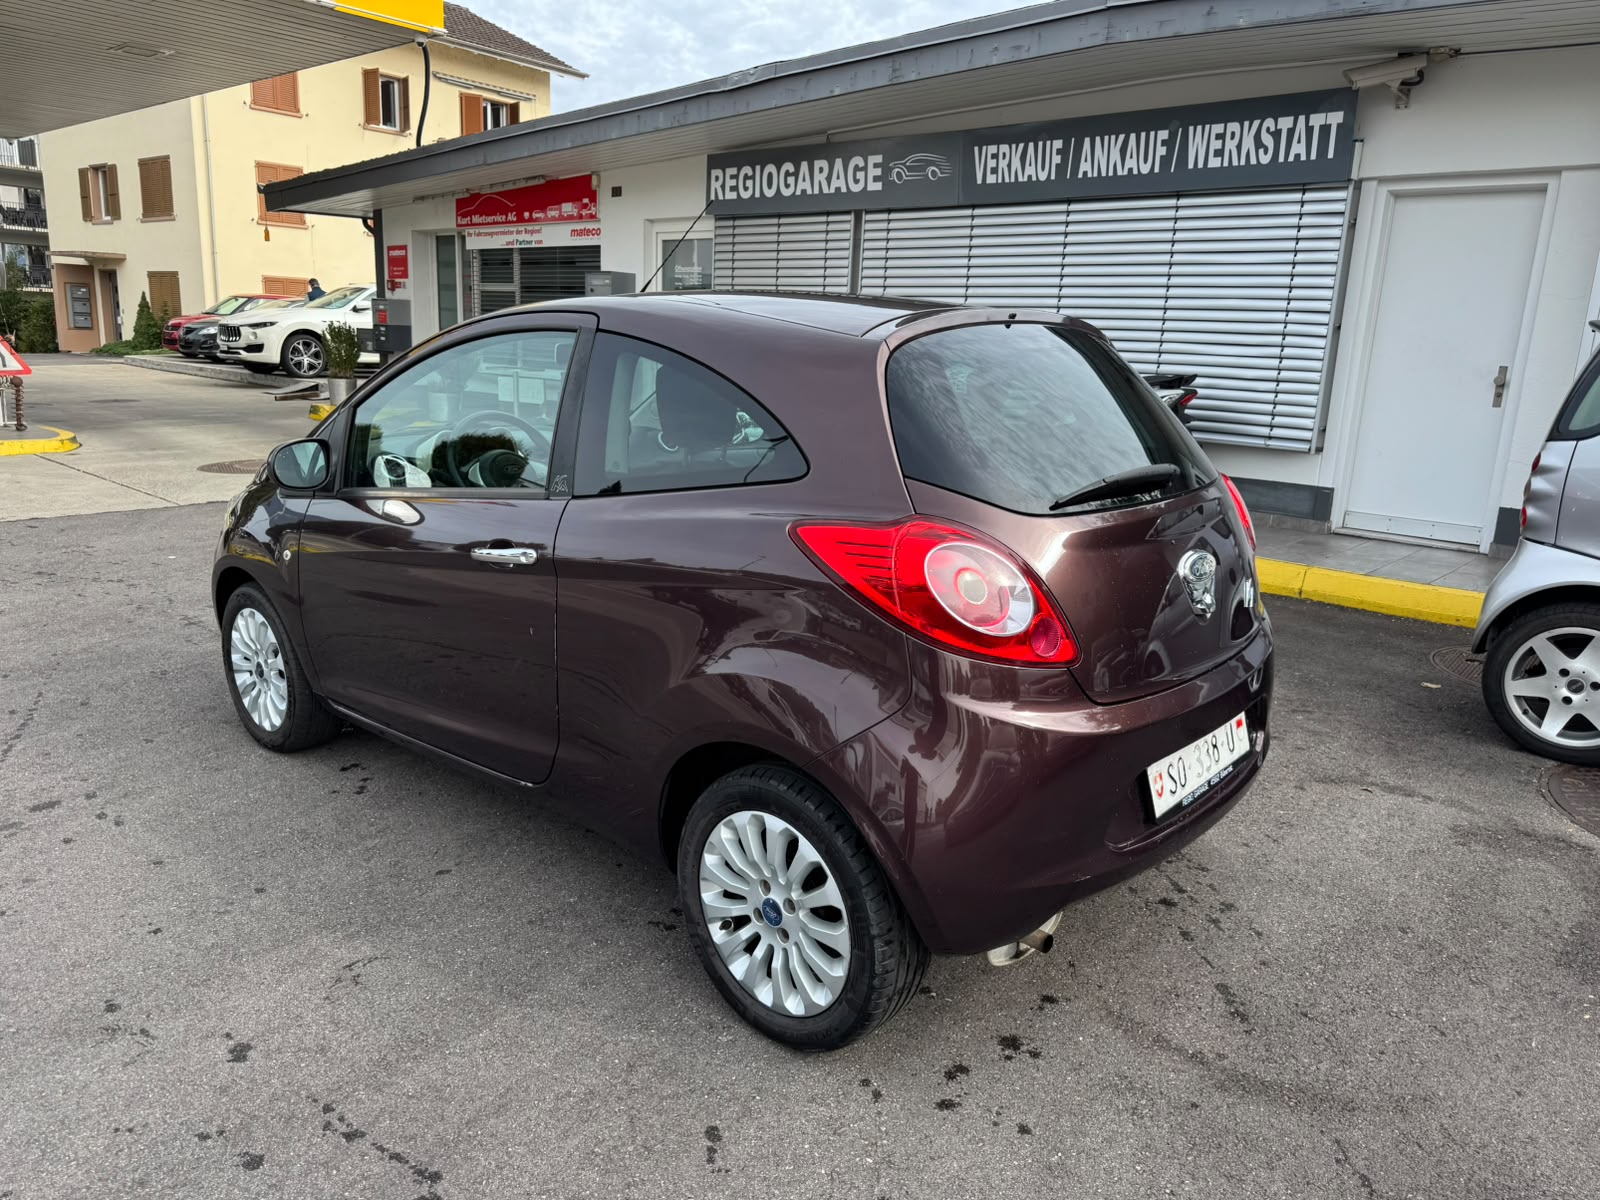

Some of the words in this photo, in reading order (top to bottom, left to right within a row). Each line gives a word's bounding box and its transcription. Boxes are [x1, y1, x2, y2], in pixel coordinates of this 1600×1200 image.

[974, 139, 1063, 184] VERKAUF
[1066, 137, 1075, 179] /
[1078, 129, 1169, 178] ANKAUF
[1171, 127, 1182, 173] /
[1187, 111, 1344, 169] WERKSTATT
[710, 155, 883, 201] REGIOGARAGE
[457, 215, 471, 225] Kurt
[471, 213, 506, 224] Mietservice
[507, 212, 517, 222] AG
[515, 227, 523, 235] der
[524, 227, 543, 236] Region!
[570, 227, 601, 237] mateco
[1167, 756, 1188, 795] SO
[1193, 735, 1221, 778] 338
[1226, 722, 1236, 753] U
